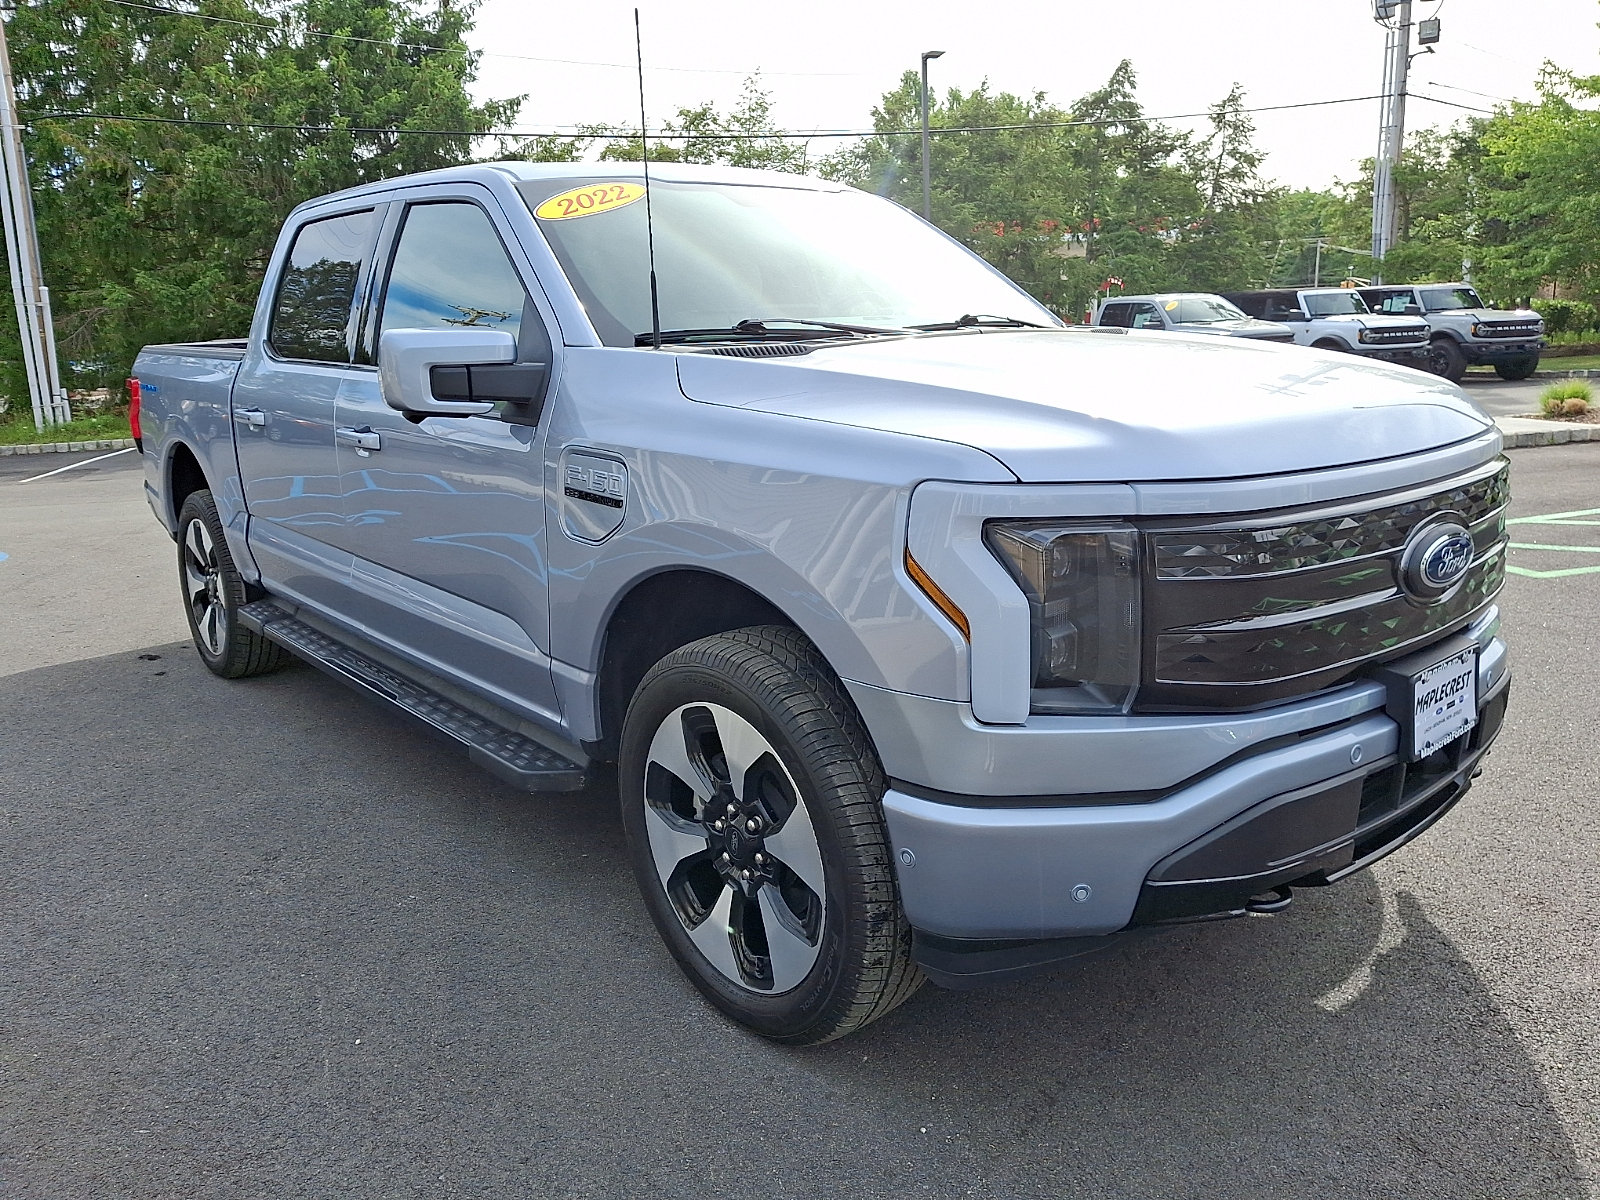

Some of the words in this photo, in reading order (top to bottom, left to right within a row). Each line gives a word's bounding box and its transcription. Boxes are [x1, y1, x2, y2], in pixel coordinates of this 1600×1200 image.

[557, 185, 630, 216] 2022
[565, 464, 624, 498] F-150
[1438, 544, 1467, 577] Ford
[1415, 670, 1473, 716] MAPLECREST
